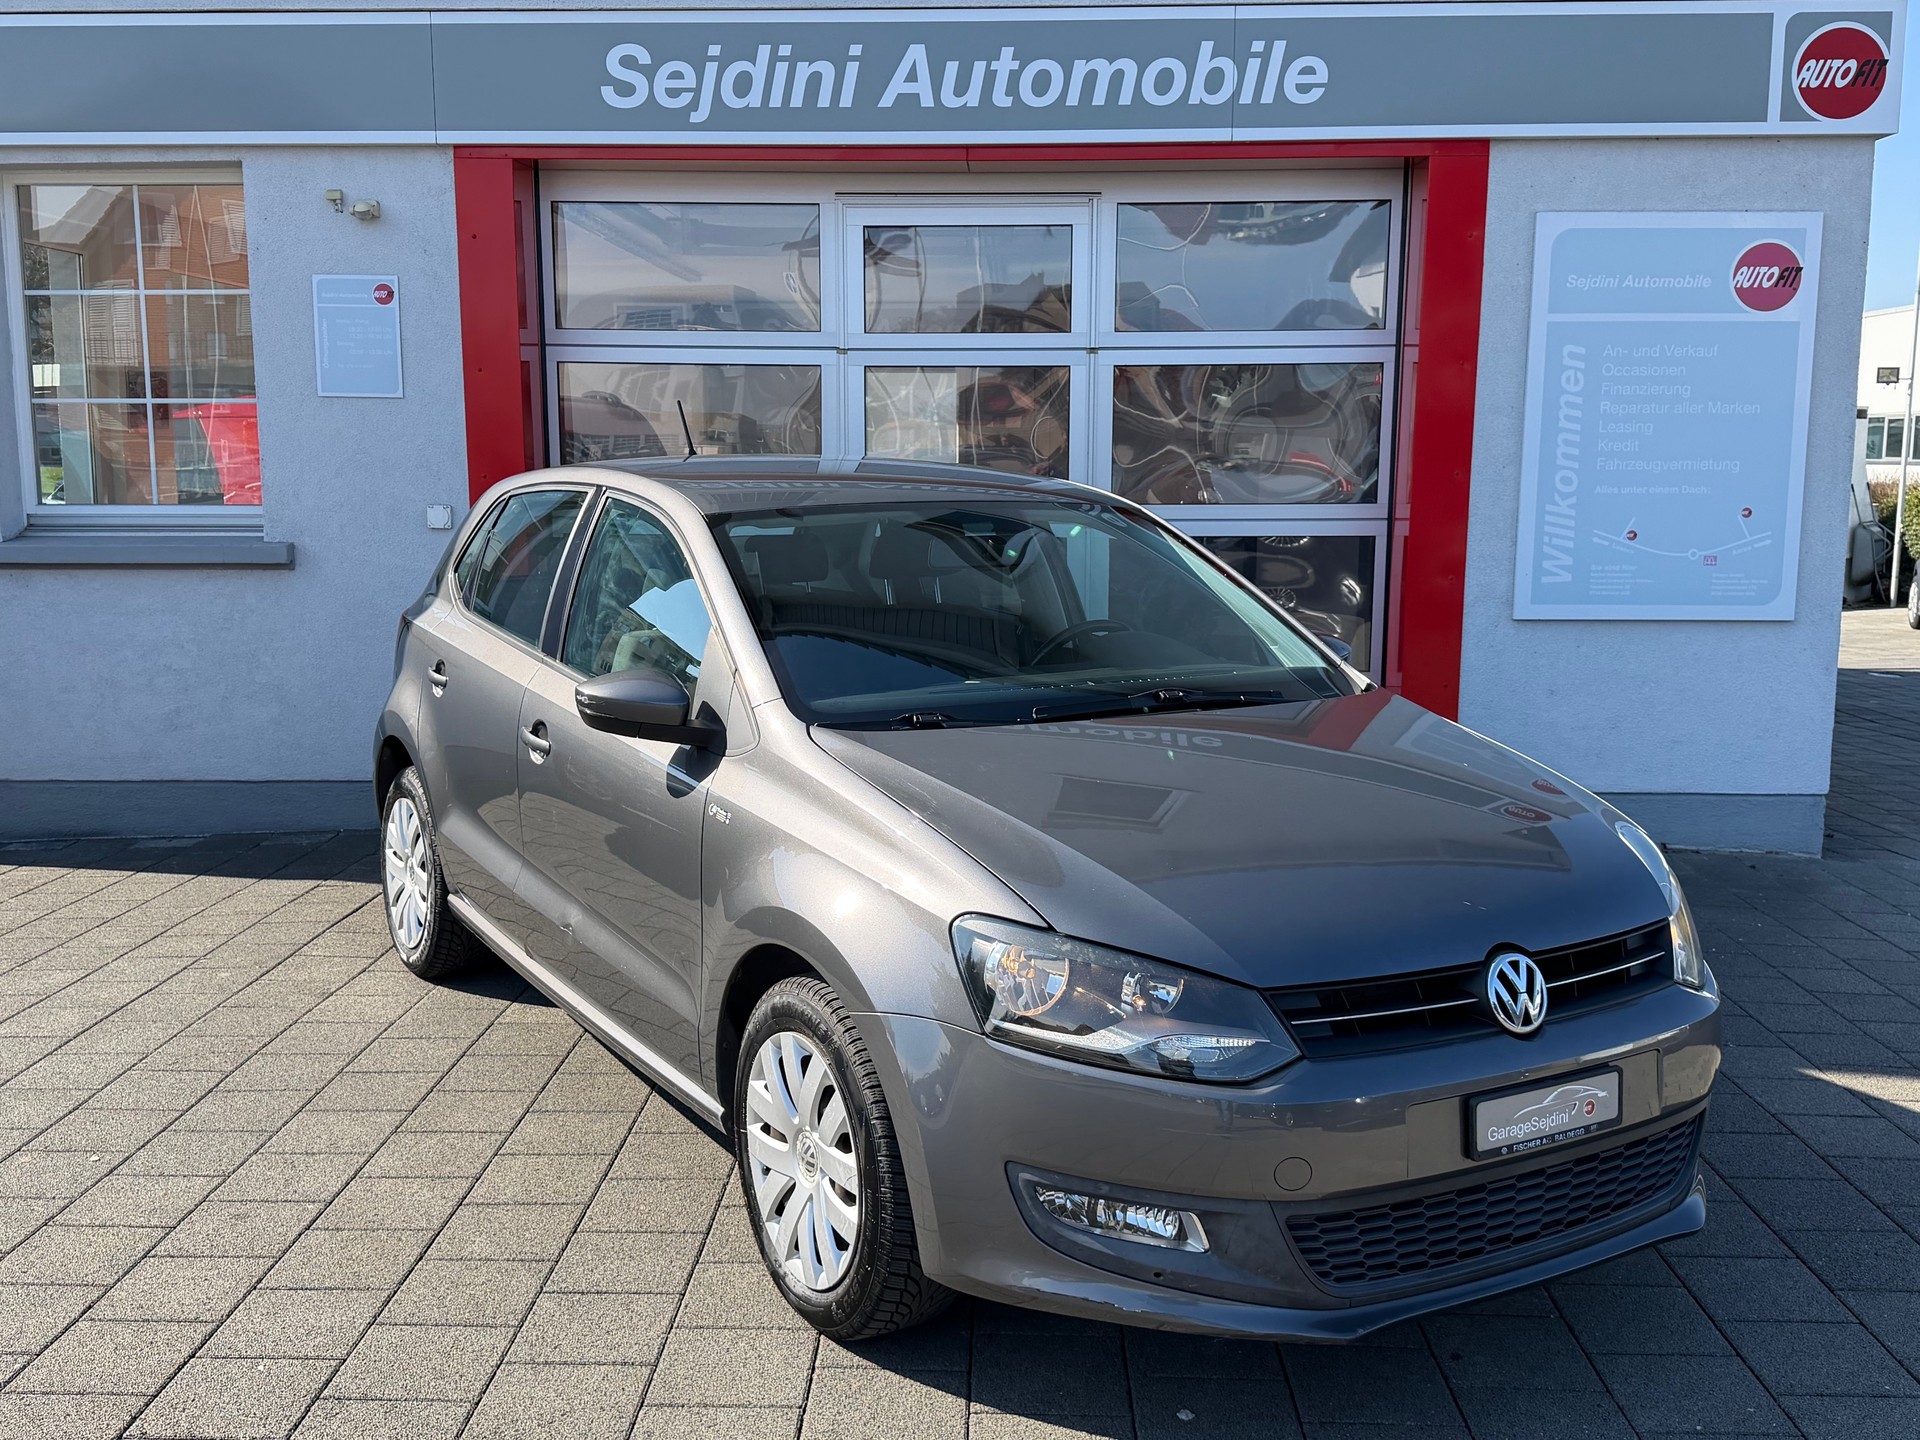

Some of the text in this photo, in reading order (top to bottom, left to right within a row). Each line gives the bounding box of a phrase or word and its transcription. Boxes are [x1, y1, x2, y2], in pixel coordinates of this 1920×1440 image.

[600, 40, 1329, 123] Sejdini Automobile
[1797, 58, 1890, 89] AUTOFIT
[1566, 273, 1713, 290] Sejdini Automobile
[1732, 265, 1804, 289] AUTOFIT
[1603, 343, 1719, 357] An- und Verkauf
[1602, 363, 1686, 377] Occasionen
[1600, 382, 1691, 399] Finanzierung
[1600, 401, 1761, 417] Reparatur aller Marken
[1598, 420, 1654, 436] Leasing
[1597, 439, 1640, 452] Kredit
[1540, 344, 1587, 584] Willkommen
[1596, 457, 1741, 473] Fahrzeugvermietung
[1594, 485, 1619, 495] Alles
[1621, 486, 1647, 495] unter
[1487, 1109, 1570, 1142] GarageSejdini
[1512, 1138, 1541, 1153] FISCHER
